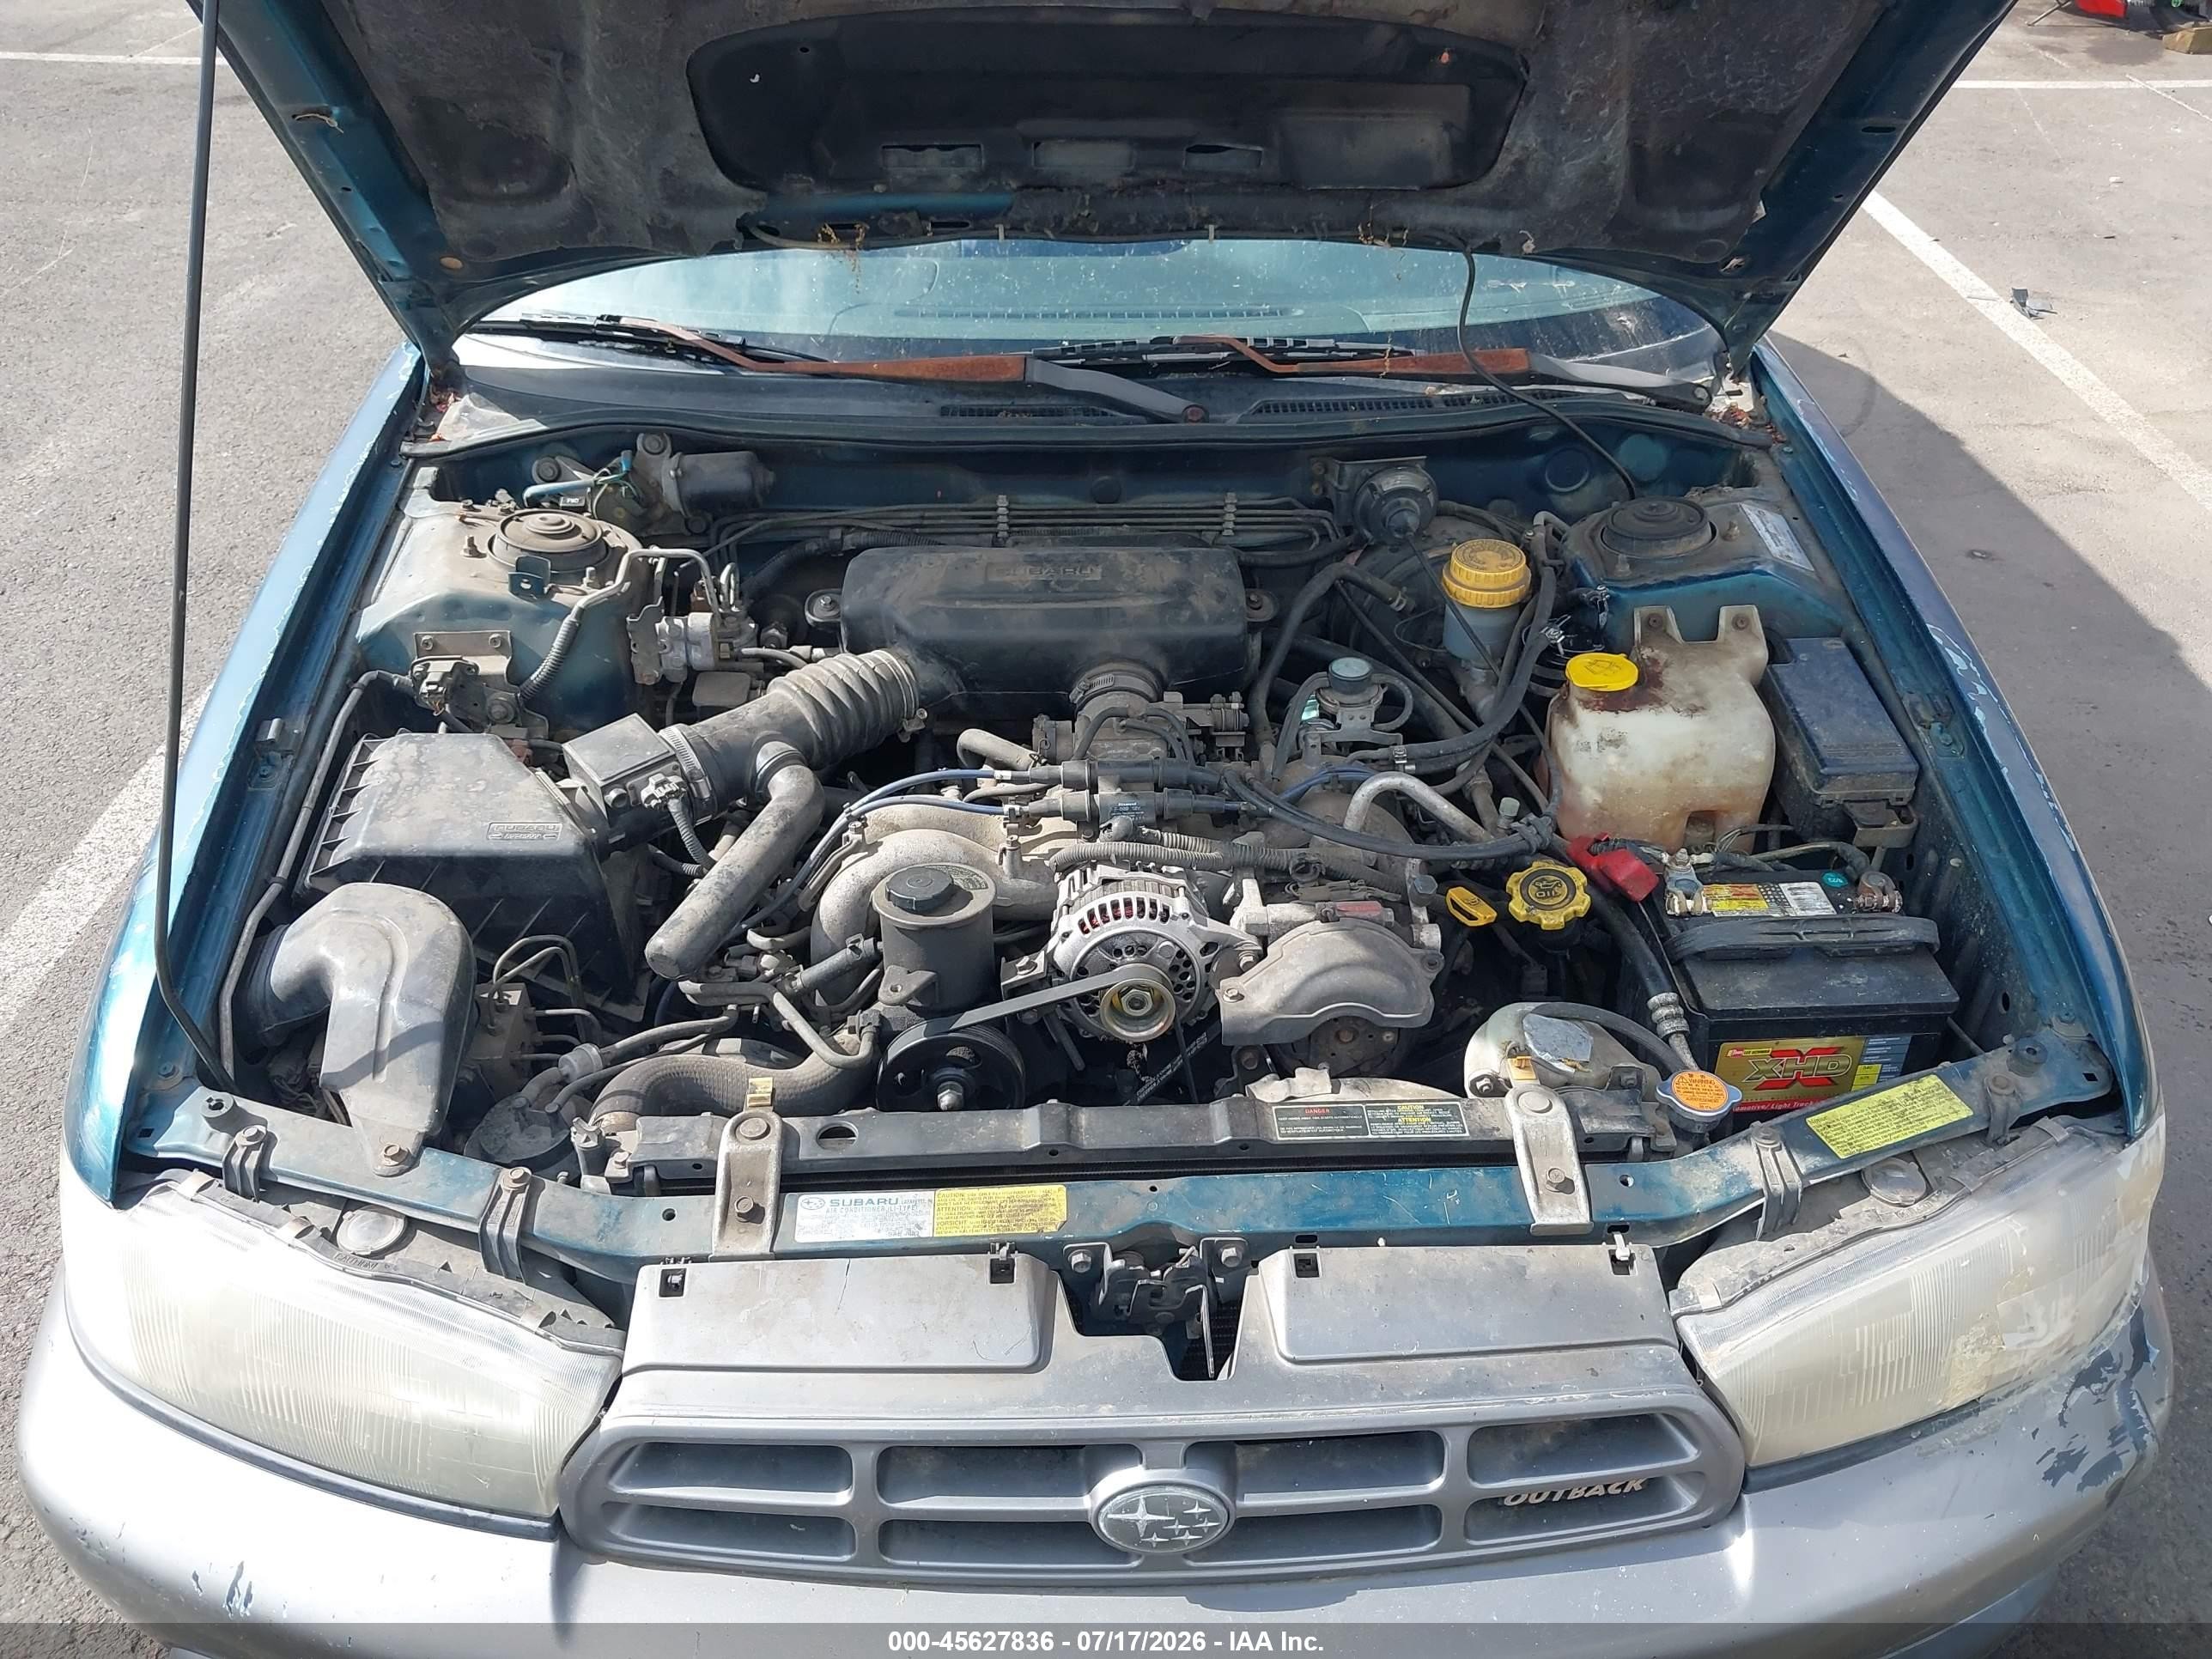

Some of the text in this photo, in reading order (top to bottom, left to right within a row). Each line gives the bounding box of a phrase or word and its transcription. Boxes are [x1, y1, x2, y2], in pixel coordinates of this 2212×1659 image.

[1742, 1054, 1852, 1083] XHD
[830, 1197, 899, 1207] SUBARU
[1504, 1478, 1648, 1506] OUTBACK
